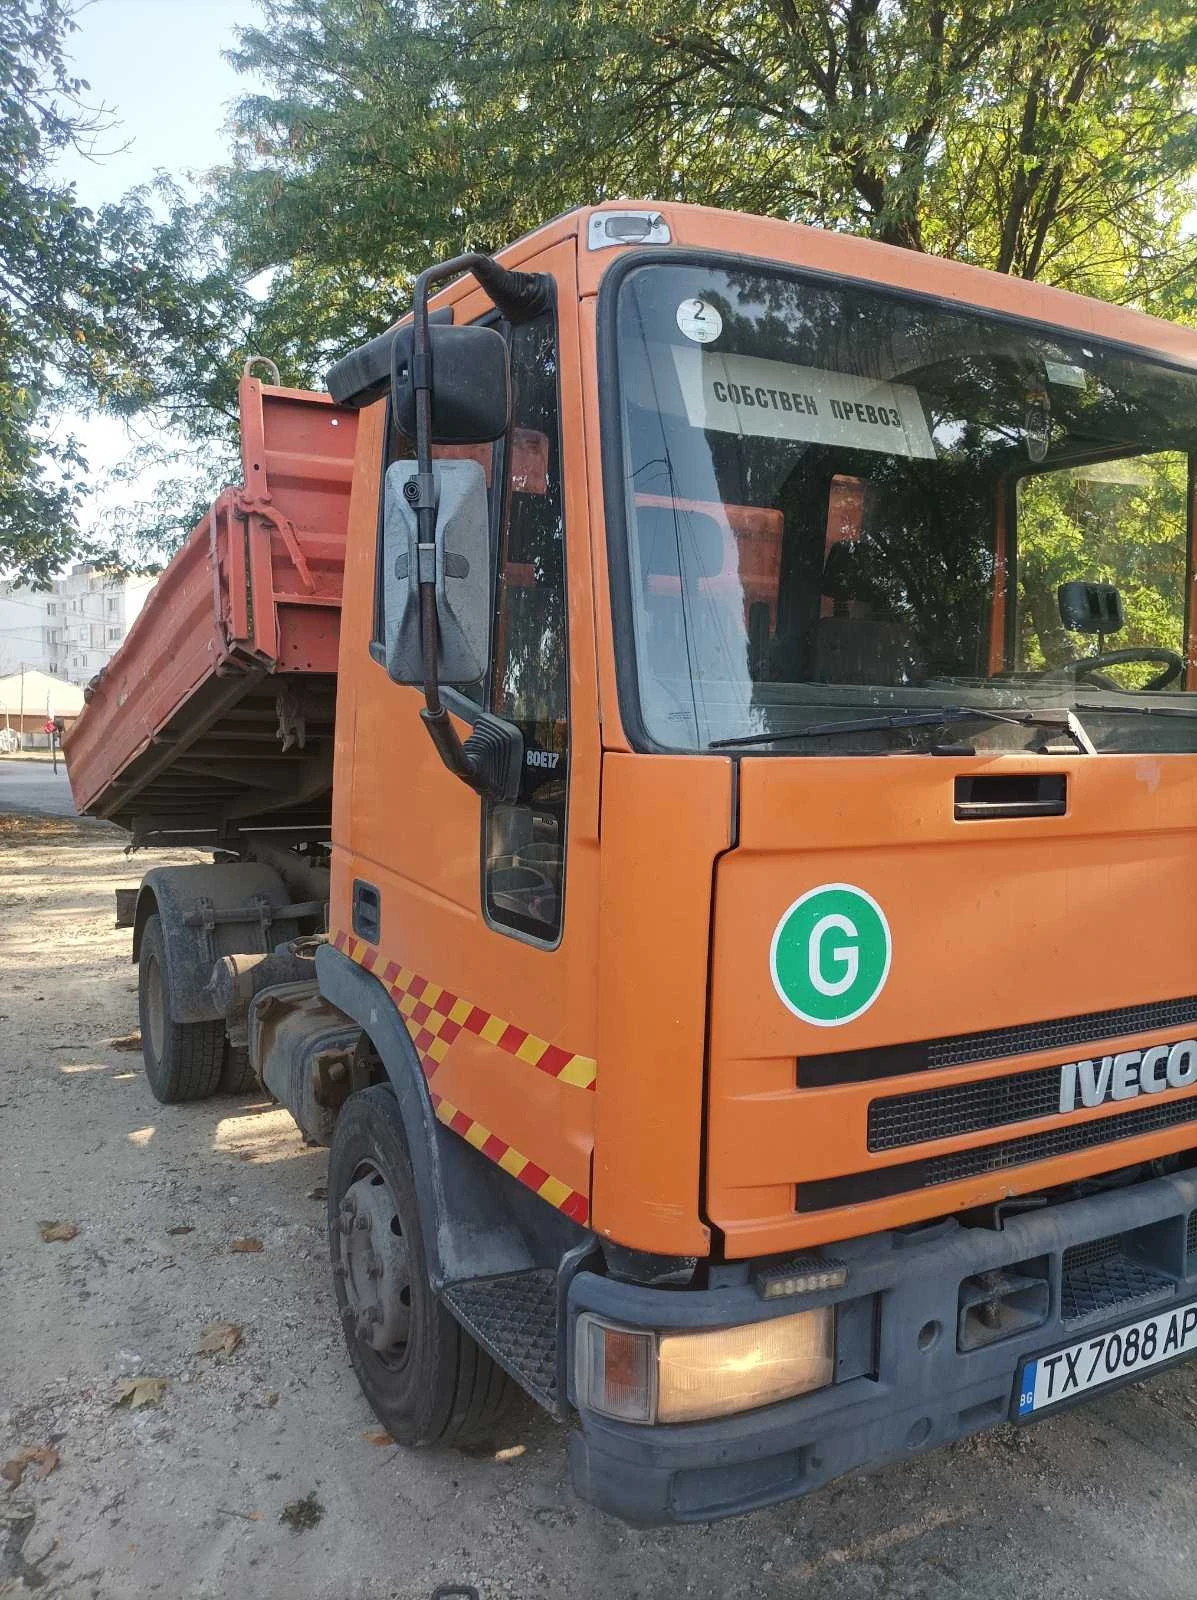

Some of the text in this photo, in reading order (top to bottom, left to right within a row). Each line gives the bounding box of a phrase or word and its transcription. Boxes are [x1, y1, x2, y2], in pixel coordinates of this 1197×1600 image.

[692, 300, 706, 321] 2
[712, 381, 902, 428] СОБСТВЕН ПРЕВОЗ
[808, 913, 859, 997] G
[1059, 1039, 1197, 1114] IVECO
[1043, 1307, 1197, 1398] TX 7088 AP
[1019, 1391, 1033, 1407] BG
